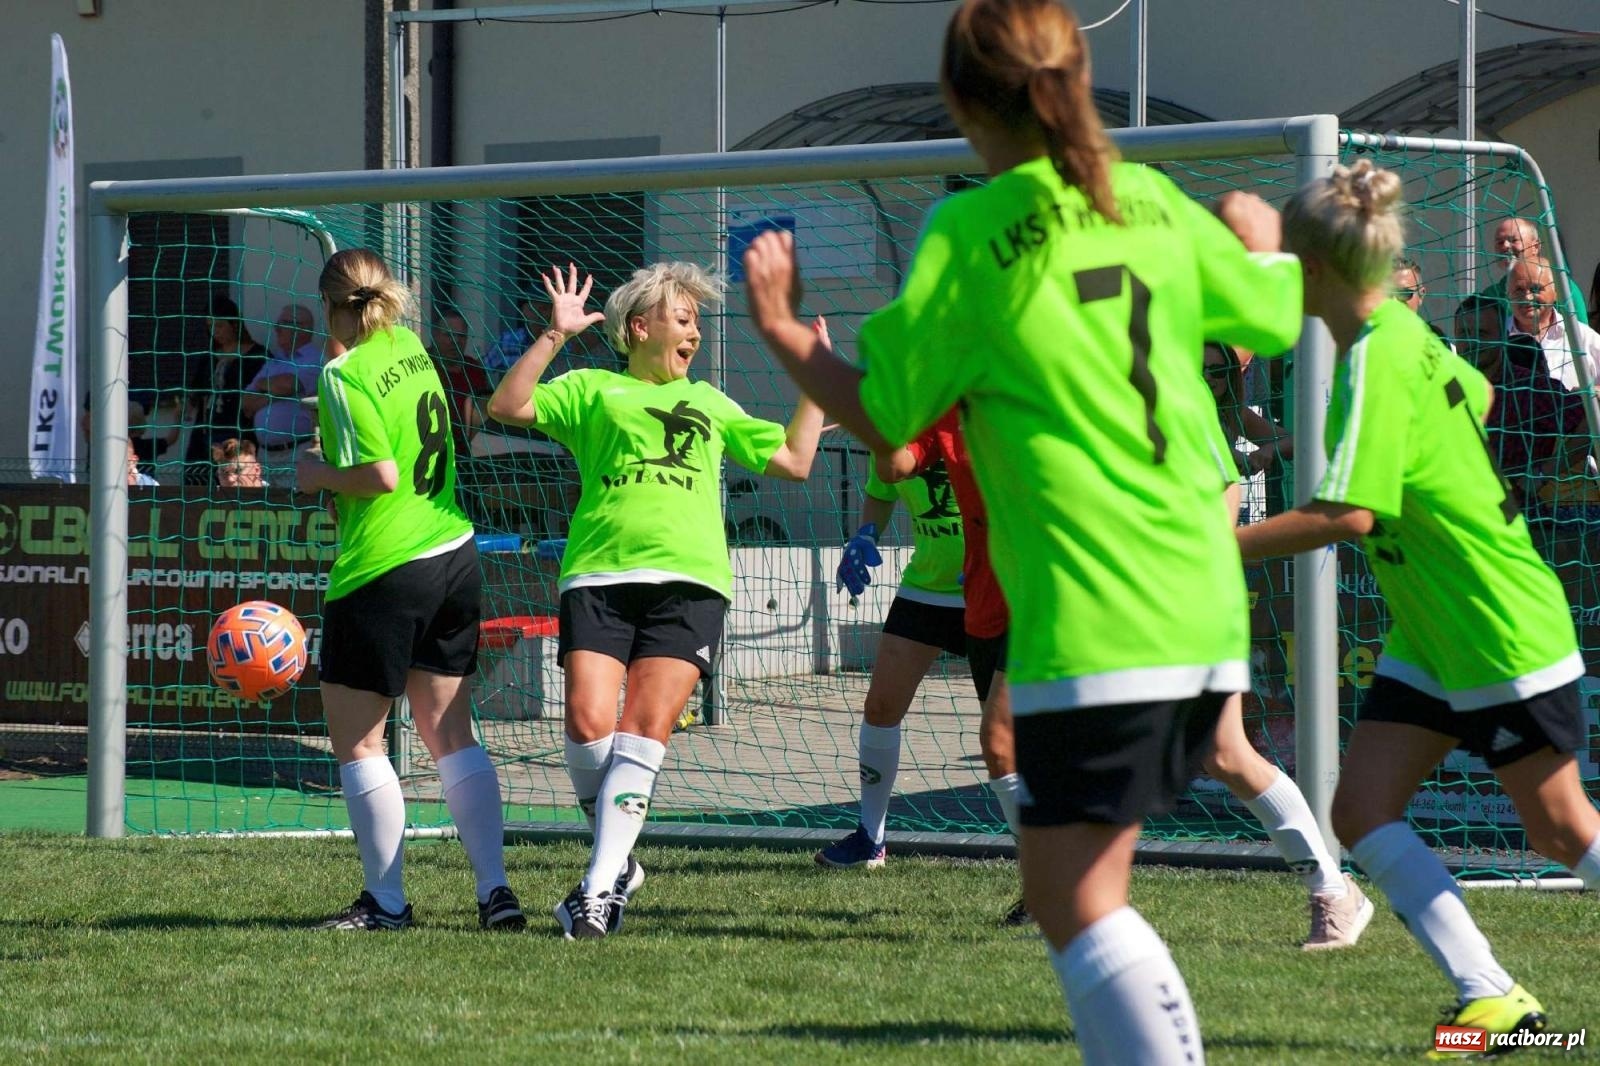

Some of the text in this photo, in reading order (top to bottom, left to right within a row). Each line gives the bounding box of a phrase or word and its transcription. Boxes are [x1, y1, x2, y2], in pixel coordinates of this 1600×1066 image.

[989, 212, 1048, 269] LKS
[376, 353, 434, 398] LKS TWOR
[1073, 264, 1167, 465] 7
[414, 391, 448, 500] 8
[198, 509, 342, 560] CENTE
[239, 572, 330, 591] SPORTO
